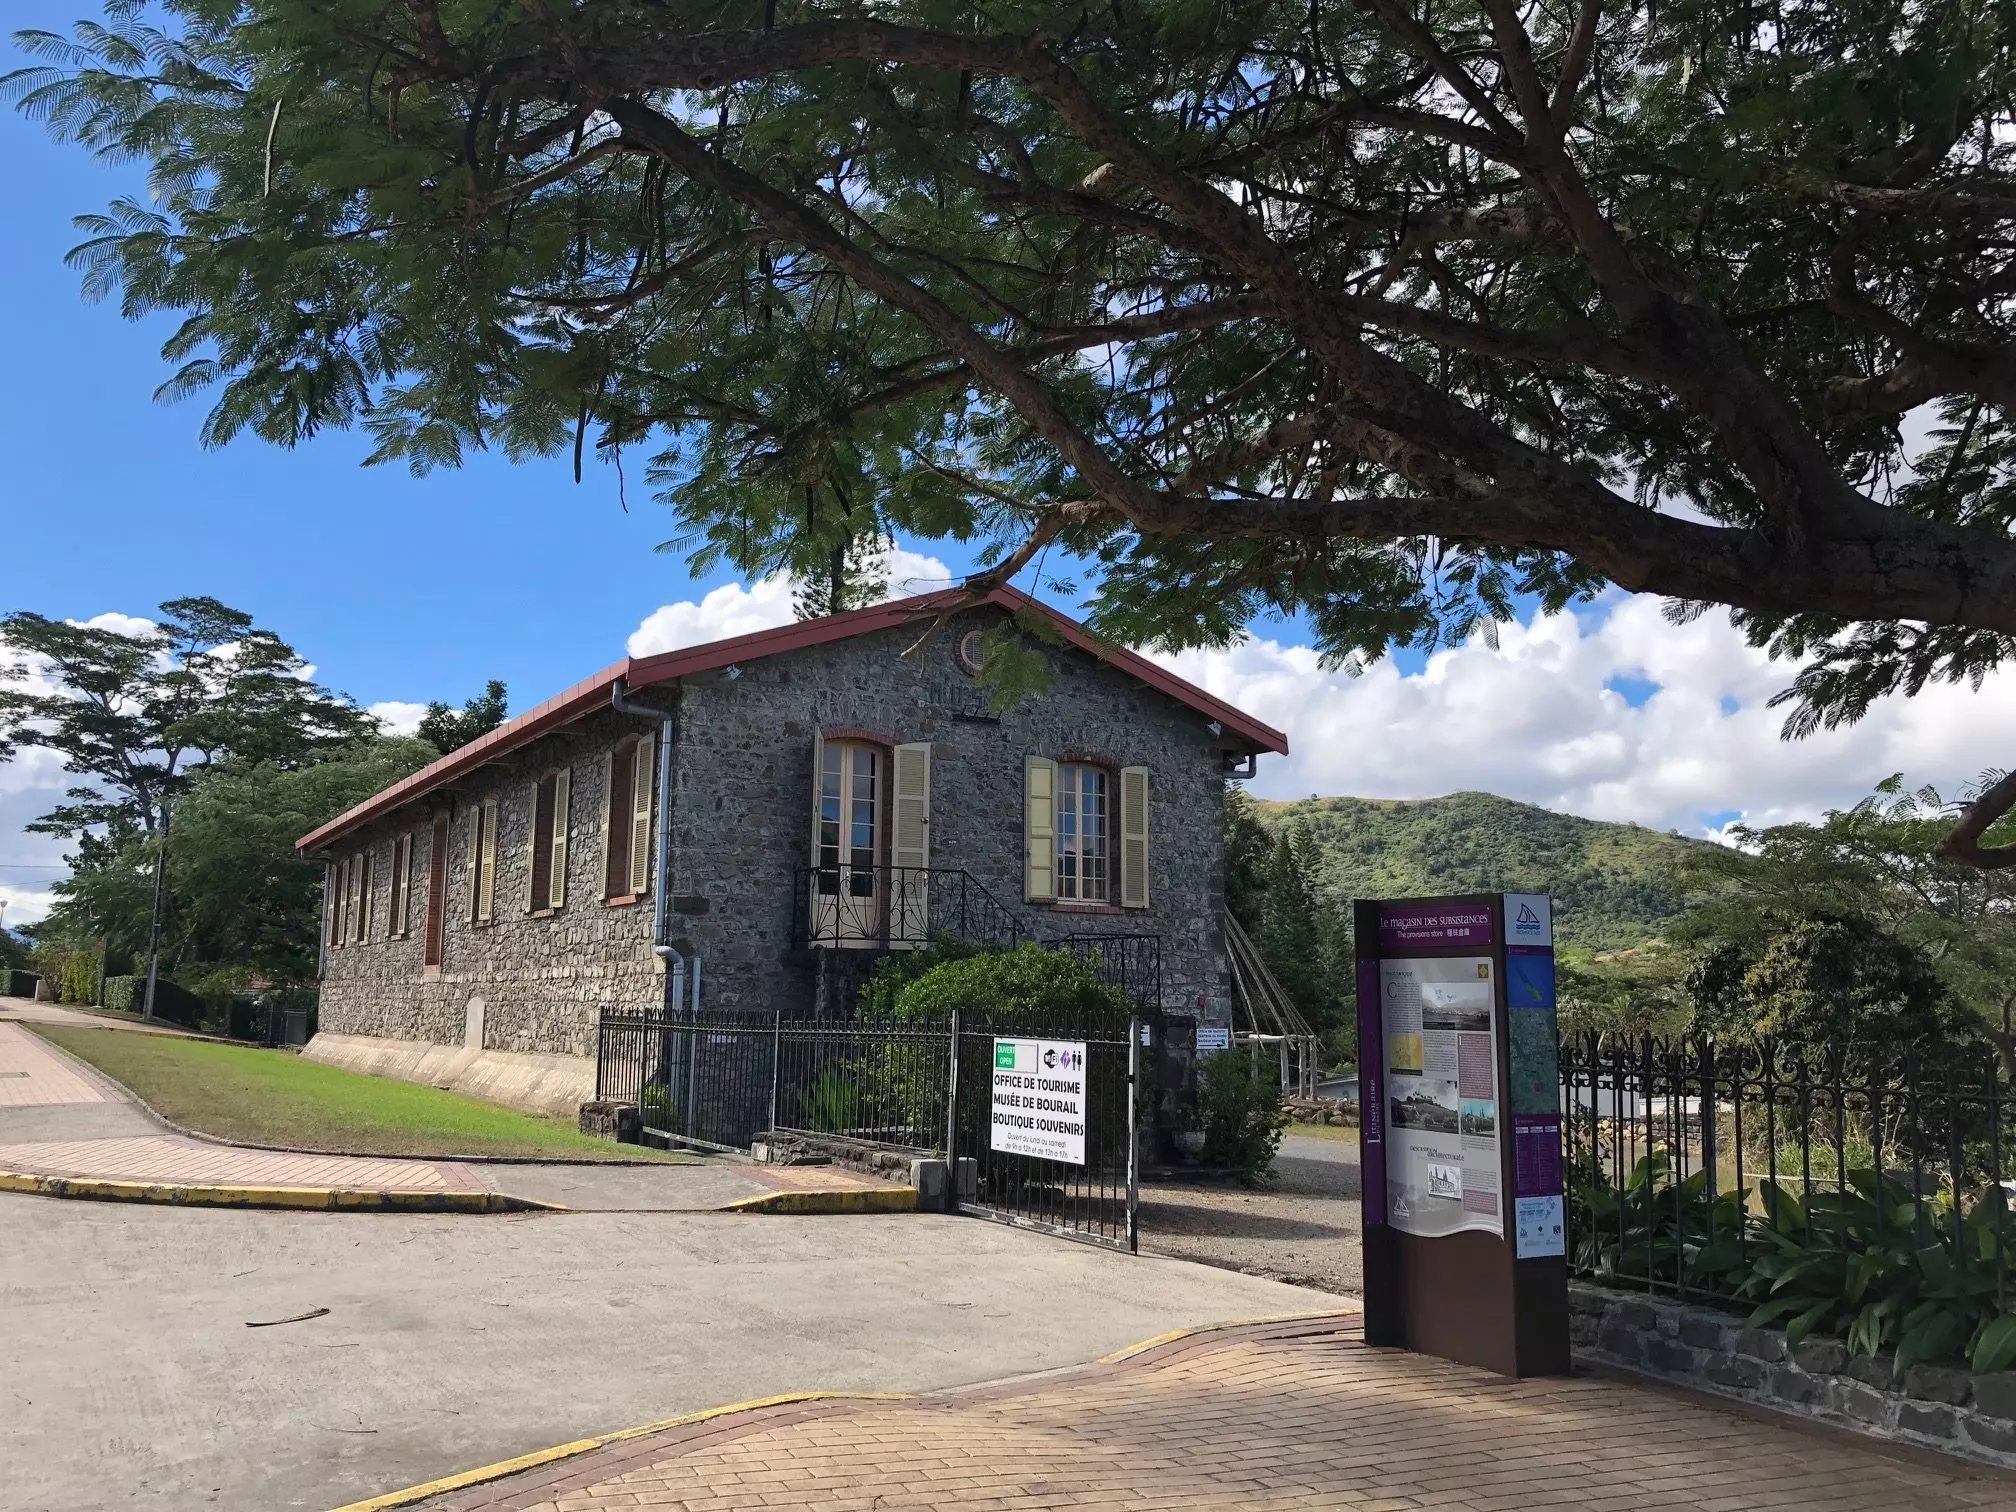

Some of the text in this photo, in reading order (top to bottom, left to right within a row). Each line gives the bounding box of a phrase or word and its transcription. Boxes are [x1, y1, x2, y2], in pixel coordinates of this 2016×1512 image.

[1407, 931, 1430, 940] provisions
[1431, 929, 1443, 938] store
[998, 1045, 1016, 1054] OUVERT
[999, 1056, 1012, 1065] OPEN
[994, 1074, 1080, 1094] OFFICE DE TOURISME
[993, 1092, 1078, 1115] MUSÉE DE BOURAIL
[993, 1112, 1084, 1136] BOUTIQUE SOUVENIRS
